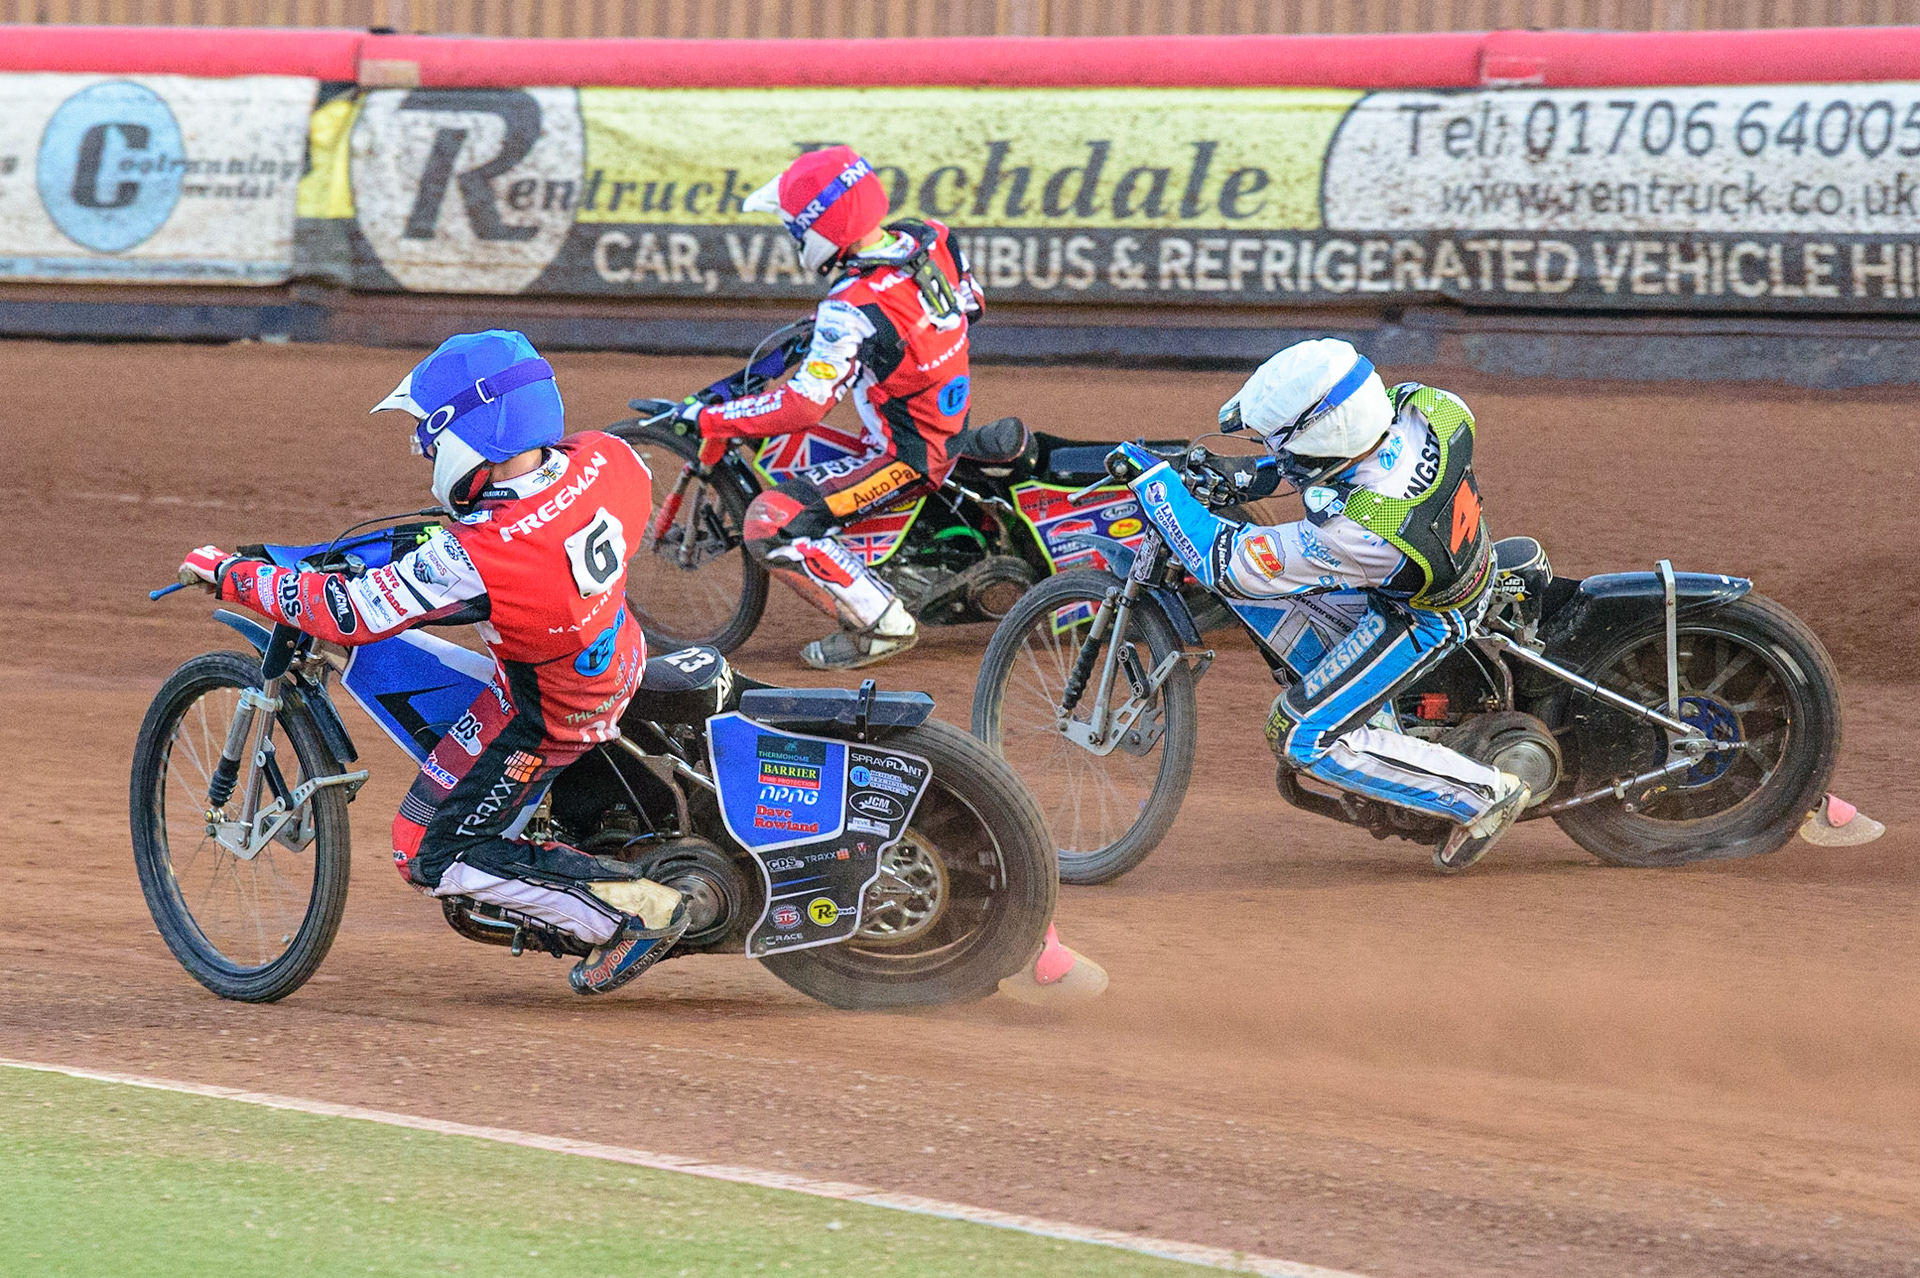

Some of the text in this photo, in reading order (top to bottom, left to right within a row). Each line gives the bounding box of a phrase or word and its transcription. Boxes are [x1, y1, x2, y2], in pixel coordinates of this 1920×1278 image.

[1524, 99, 1716, 158] 01706
[795, 140, 1271, 219] ochdale
[594, 231, 719, 294] CAR,
[726, 234, 843, 285] VA
[1108, 236, 1152, 290] &
[1159, 237, 1578, 294] REFRIGERATED
[1594, 240, 1839, 298] VEHICLE
[1851, 241, 1920, 300] HI
[499, 451, 609, 543] FREEMAN
[852, 469, 915, 507] Auto Pa
[1450, 479, 1481, 555] 4
[584, 519, 619, 585] 6
[1160, 504, 1202, 567] LAMBERTS
[455, 713, 482, 741] DS
[758, 750, 810, 763] THERMOHOME
[764, 763, 817, 779] BARRIER
[851, 752, 924, 777] SPRAYPLANT
[456, 776, 517, 837] TRAXX
[756, 805, 792, 818] Dave
[864, 796, 891, 809] JCM
[754, 817, 819, 833] Rowland
[769, 851, 837, 870] CDS TRAXX
[774, 911, 798, 923] STS
